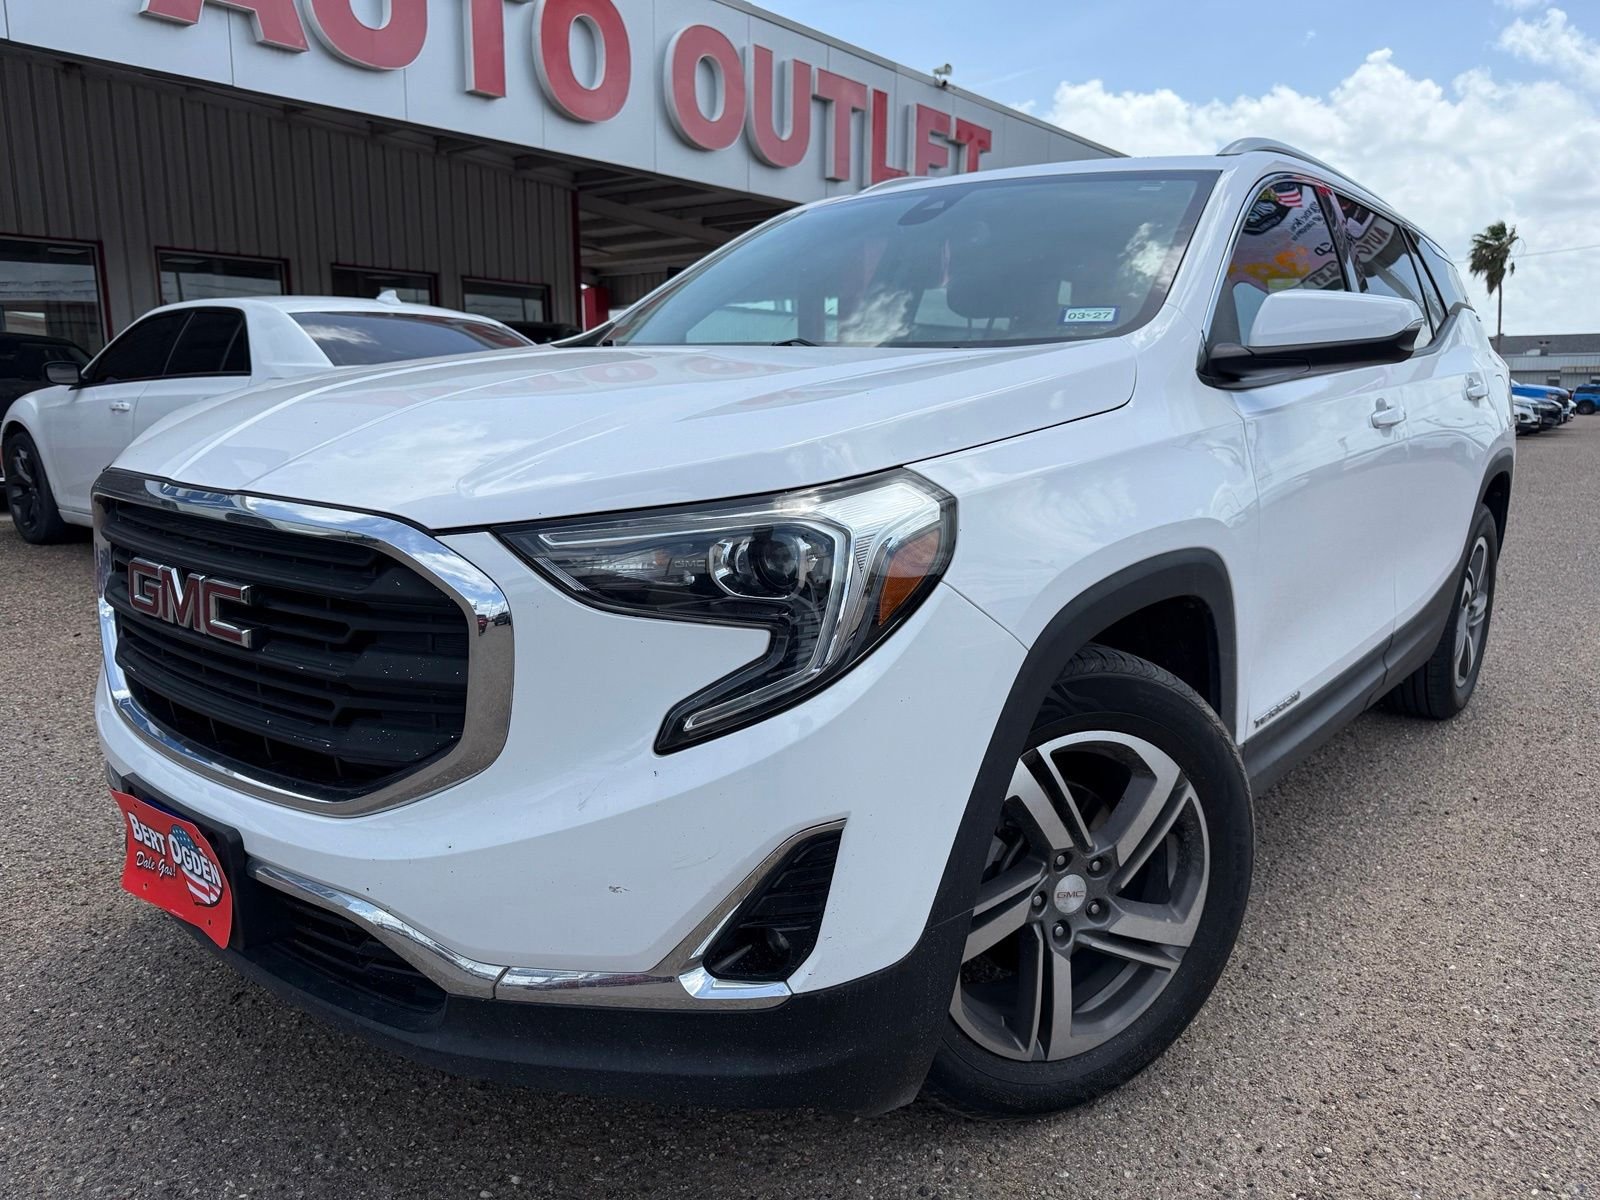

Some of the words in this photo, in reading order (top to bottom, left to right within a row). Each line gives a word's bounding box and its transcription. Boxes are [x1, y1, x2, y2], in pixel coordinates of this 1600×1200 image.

[664, 24, 992, 188] OUTLET
[128, 557, 252, 648] GMC
[128, 812, 165, 855] BERT
[168, 833, 222, 889] OGDEN
[135, 850, 155, 870] Dale
[157, 858, 176, 878] Gas!
[1057, 890, 1085, 899] GMC
